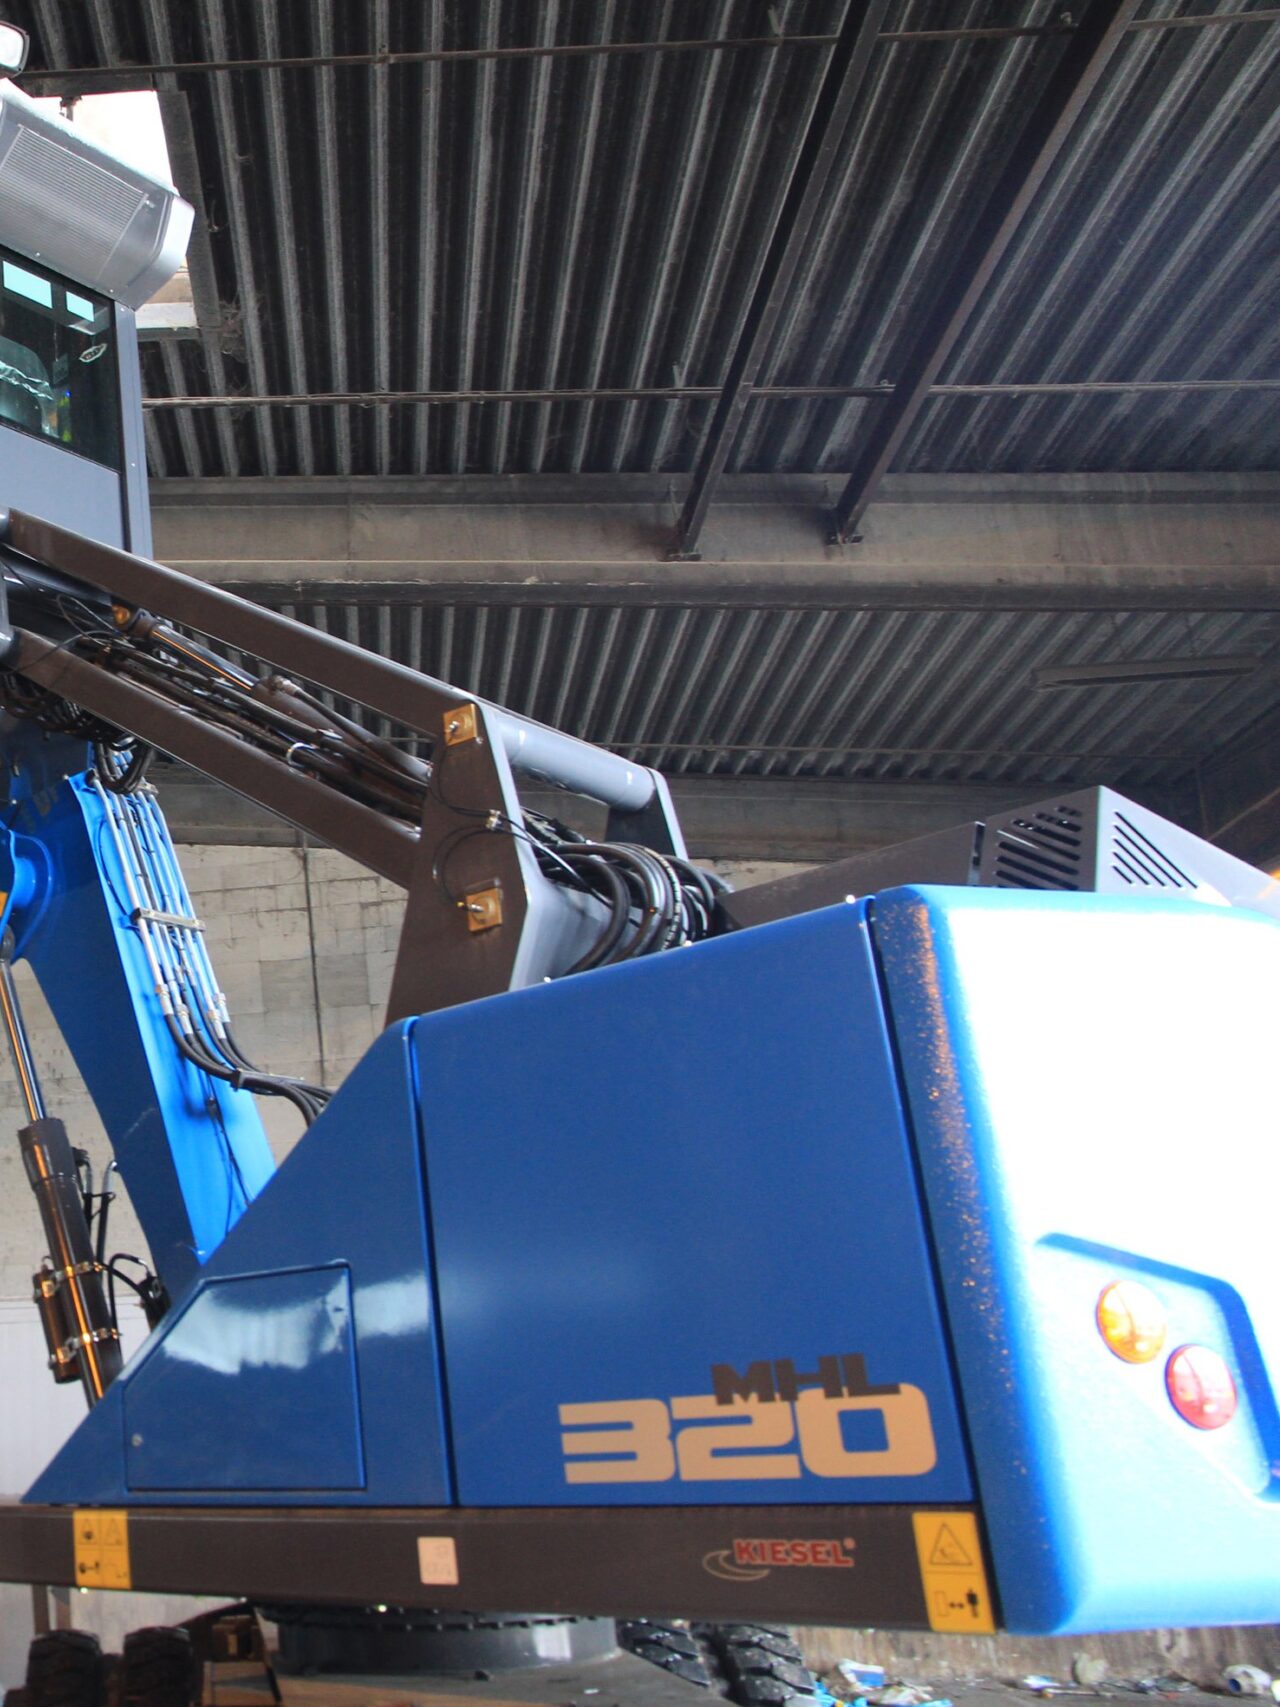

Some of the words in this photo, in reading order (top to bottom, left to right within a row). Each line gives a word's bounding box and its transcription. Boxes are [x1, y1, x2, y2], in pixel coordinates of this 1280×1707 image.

[711, 1354, 901, 1406] MHL
[558, 1383, 936, 1484] 320
[733, 1539, 854, 1567] KIESEL
